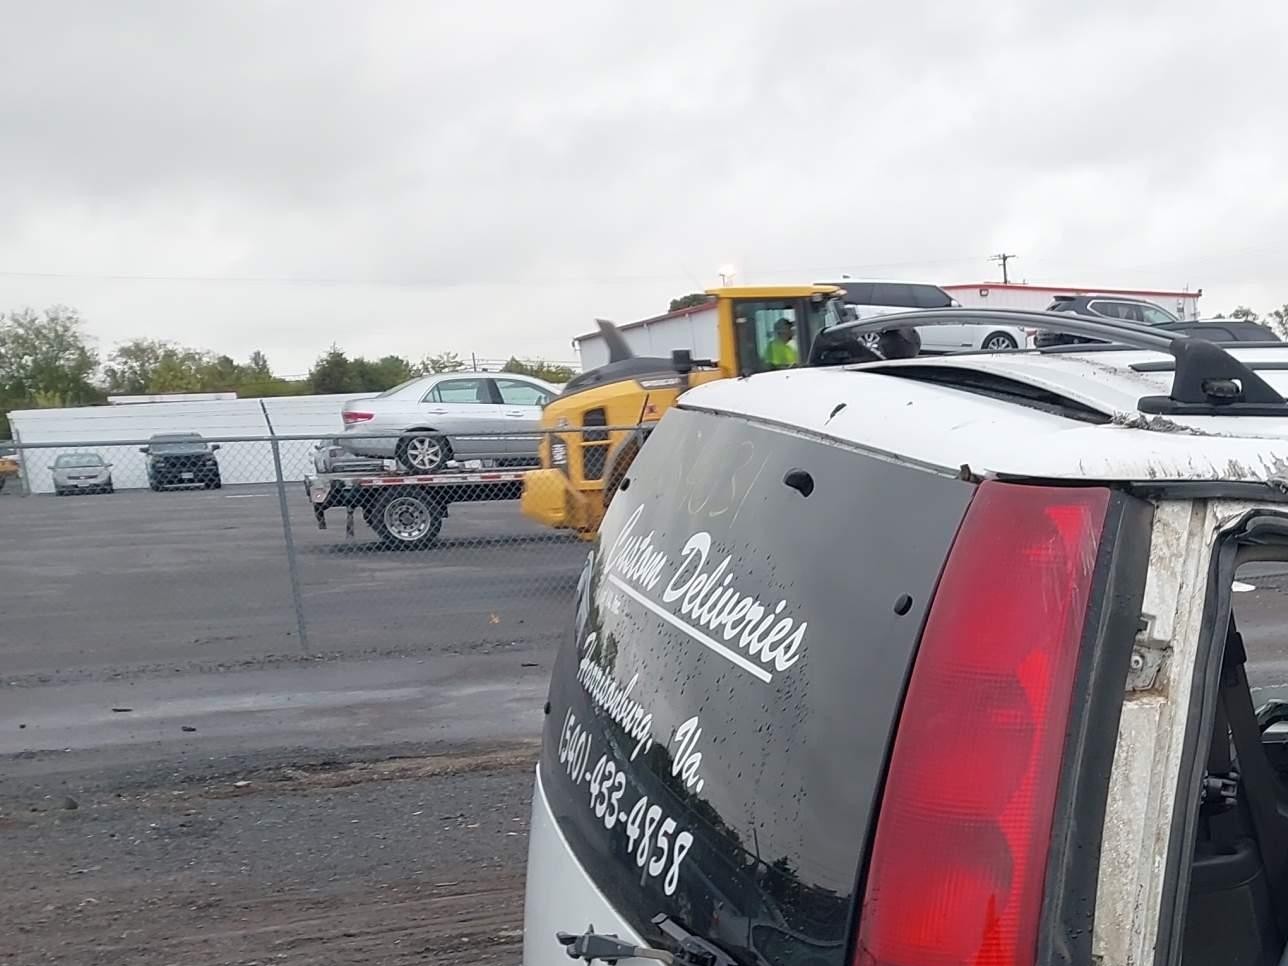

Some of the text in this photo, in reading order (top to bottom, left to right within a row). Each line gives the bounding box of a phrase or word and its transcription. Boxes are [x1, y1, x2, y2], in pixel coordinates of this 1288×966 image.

[604, 504, 807, 671] Custom Deliveries
[671, 716, 704, 793] Va.
